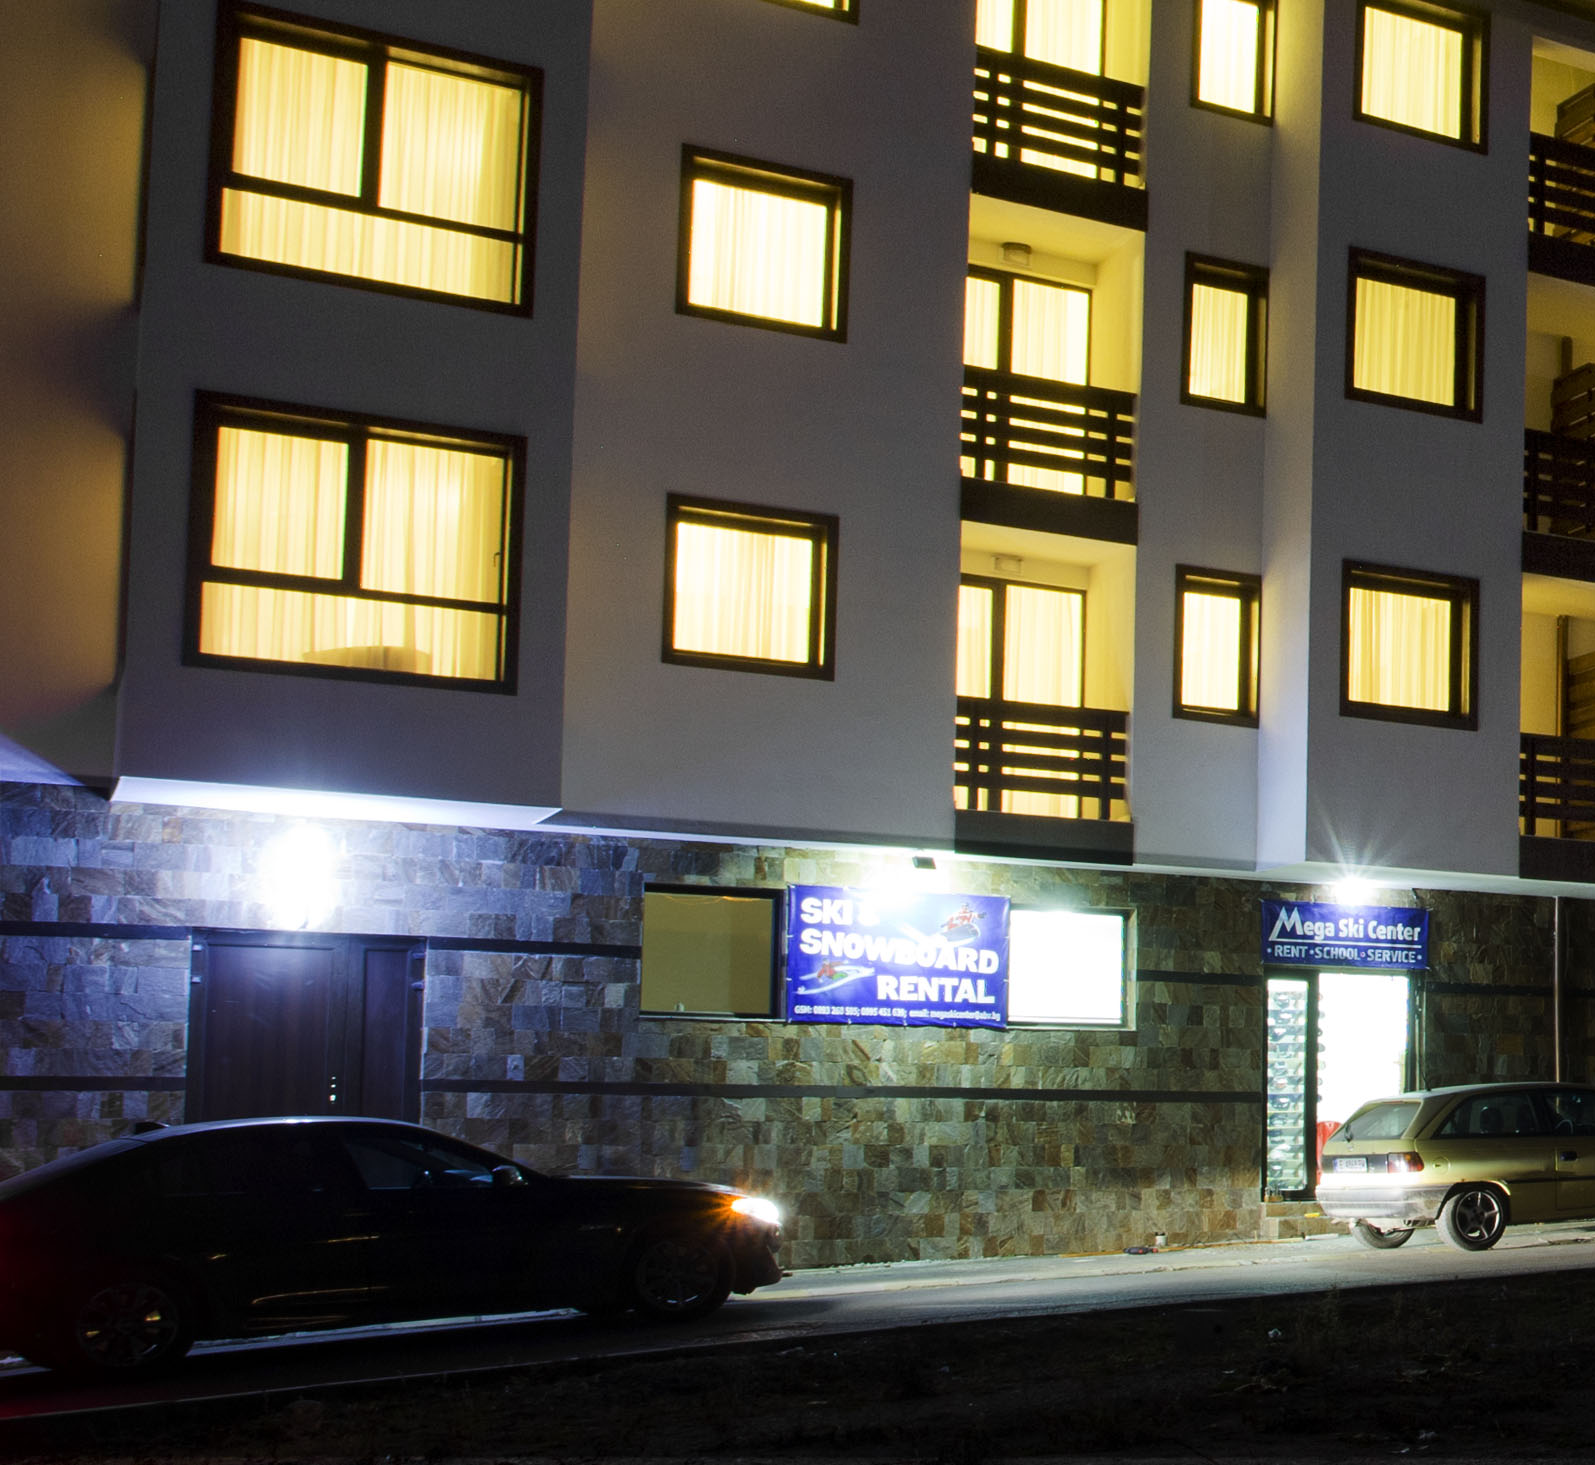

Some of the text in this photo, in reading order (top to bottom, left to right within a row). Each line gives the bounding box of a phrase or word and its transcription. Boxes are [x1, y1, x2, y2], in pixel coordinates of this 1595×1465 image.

[800, 897, 853, 925] SKI
[1268, 906, 1422, 941] Mega Ski Center
[800, 928, 1000, 974] SNOWBOARD
[1274, 944, 1416, 963] RENT SCHOOL SERVICE
[877, 975, 996, 1004] RENTAL
